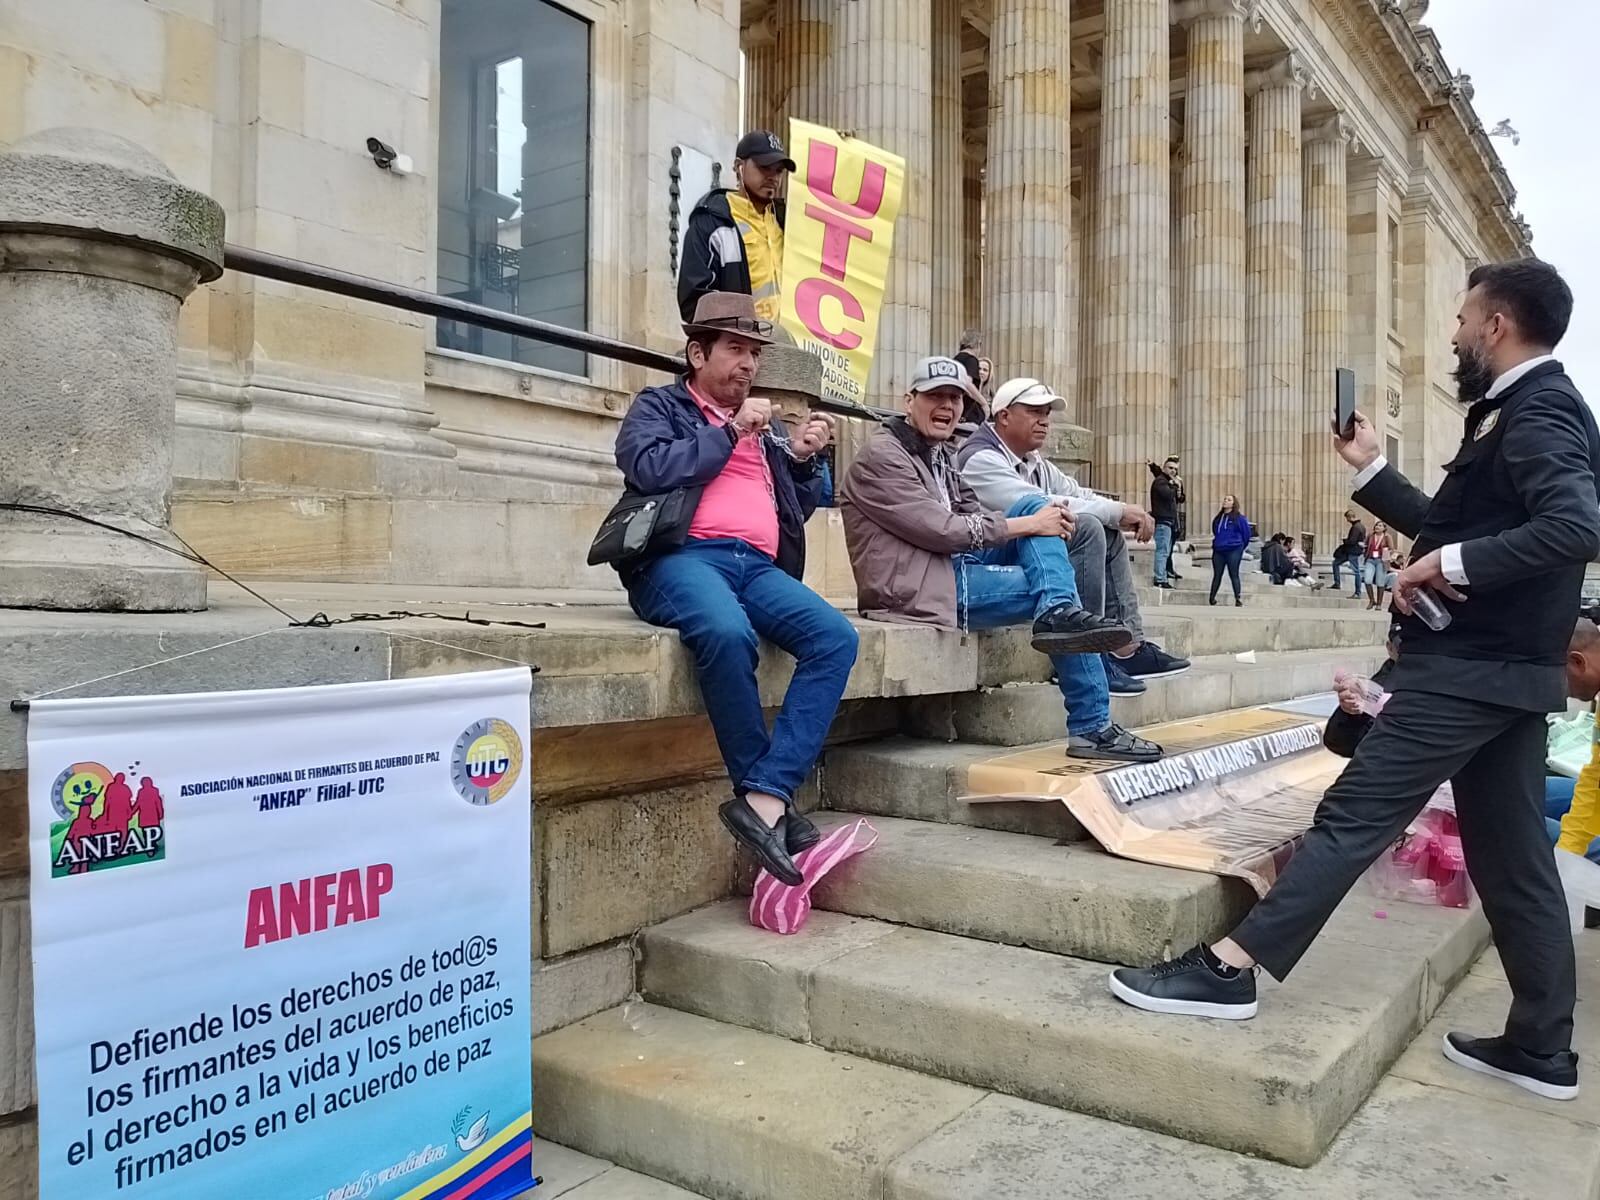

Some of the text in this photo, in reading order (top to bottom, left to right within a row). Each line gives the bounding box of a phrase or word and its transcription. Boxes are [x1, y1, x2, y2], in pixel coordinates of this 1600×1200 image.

[794, 137, 887, 350] UTC
[820, 366, 859, 395] ADORES
[837, 354, 850, 373] DE
[181, 751, 440, 797] ASOCIACIÓN NACIONAL DE FIRMANTES DEL ACUERDO DE PAZ
[358, 777, 384, 796] UTC
[470, 743, 506, 779] UTC
[1109, 757, 1192, 803] DERECHOS
[1190, 741, 1257, 780] HUMANOS
[1253, 737, 1268, 761] Y
[1265, 724, 1320, 758] LABORALES
[55, 825, 164, 866] ANFAP
[243, 863, 394, 949] ANFAP
[87, 971, 501, 1117] los firmantes del acuerdo de paz,
[90, 935, 498, 1074] Defiende los derechos de tod@s
[66, 996, 514, 1167] el derecho a la vida y los beneficios
[114, 1036, 492, 1190] firmados en el acuerdo de paz
